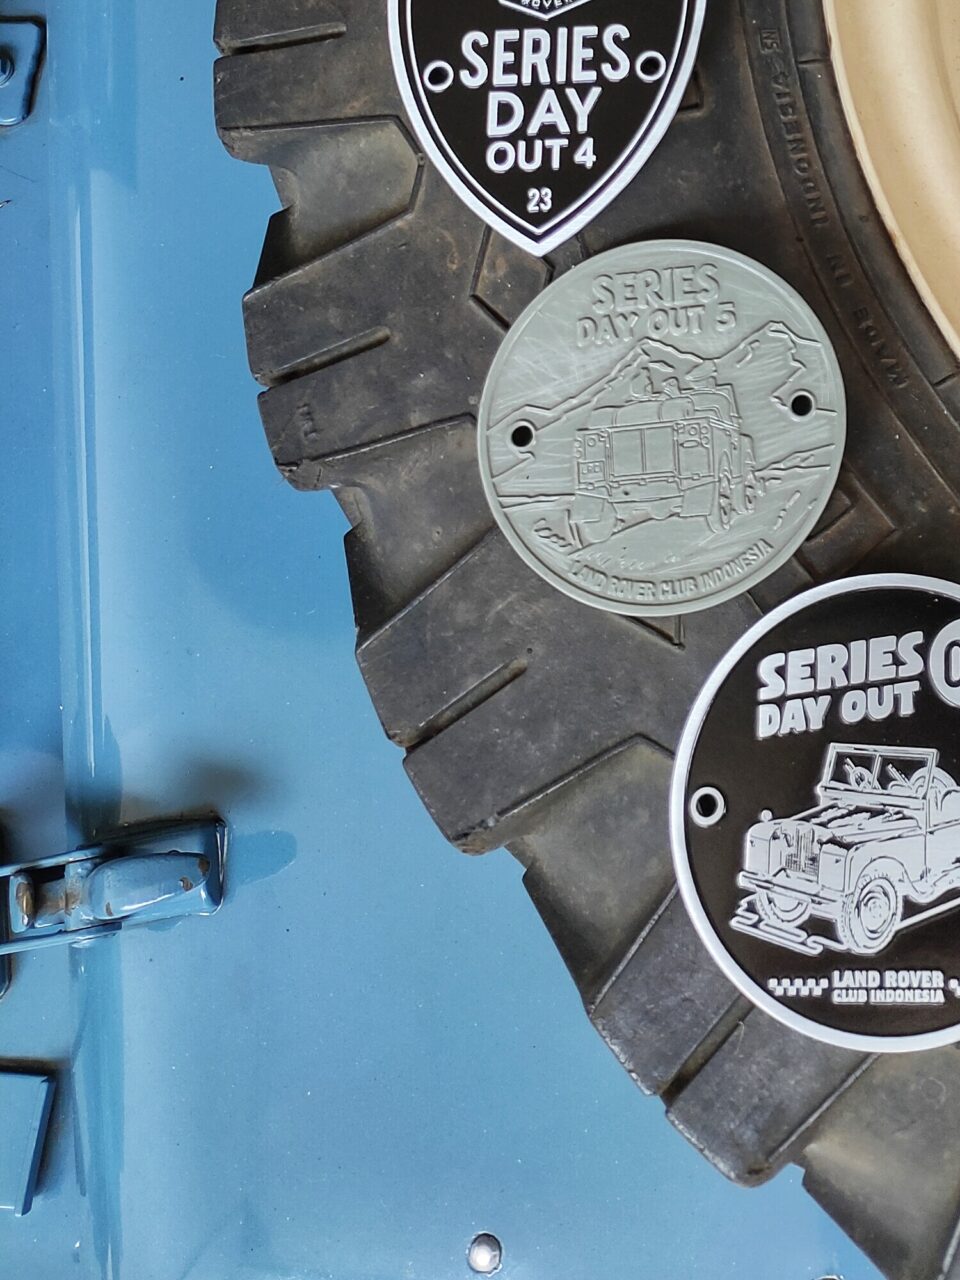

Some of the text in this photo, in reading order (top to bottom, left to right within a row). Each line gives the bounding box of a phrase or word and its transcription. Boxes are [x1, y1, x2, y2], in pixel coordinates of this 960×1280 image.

[459, 23, 631, 89] SERIES
[486, 86, 602, 138] DAY
[485, 137, 597, 173] OUT 4
[527, 187, 553, 212] 23
[592, 263, 720, 314] SERIES
[576, 301, 737, 348] DAY OUT 5
[569, 537, 775, 601] LAND ROVER CLUB INDONESIA
[757, 630, 926, 702] SERIES
[756, 680, 921, 741] DAY OUT
[832, 969, 945, 989] LAND ROVER
[832, 988, 945, 1005] CLUB INDONESIA
